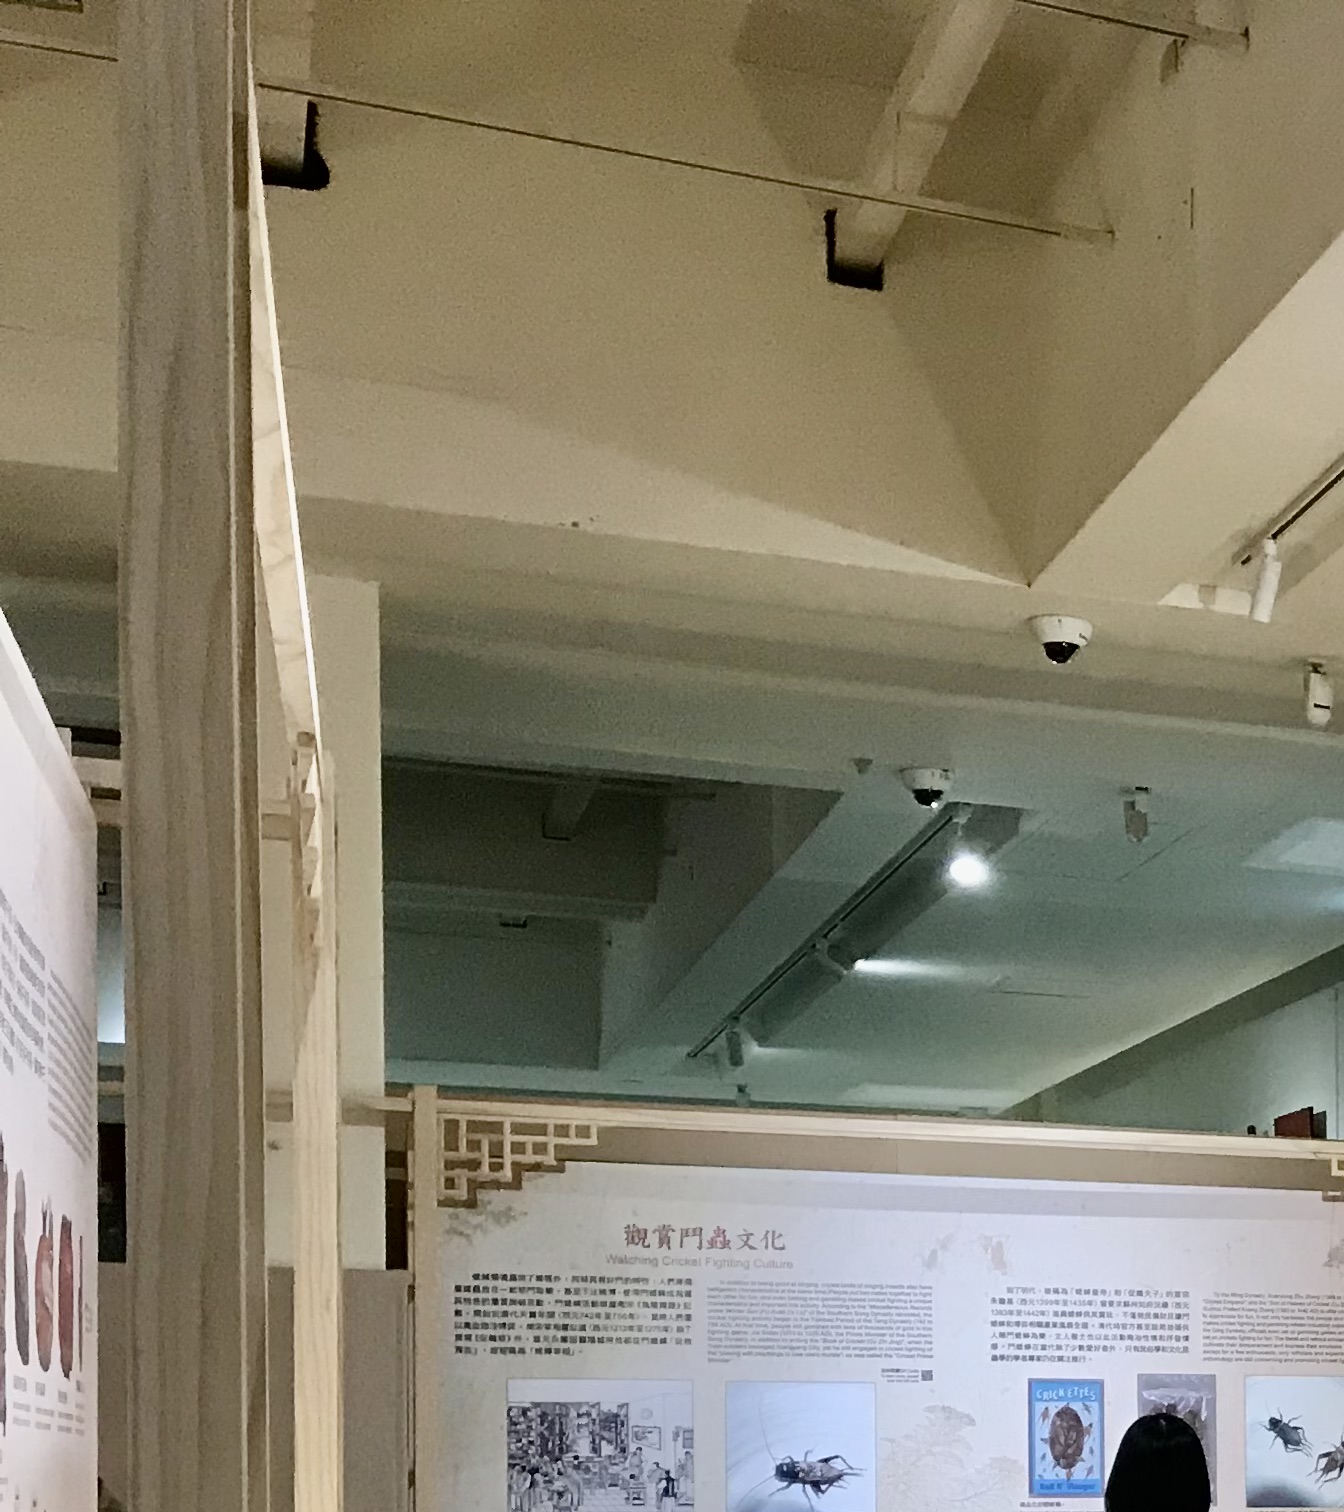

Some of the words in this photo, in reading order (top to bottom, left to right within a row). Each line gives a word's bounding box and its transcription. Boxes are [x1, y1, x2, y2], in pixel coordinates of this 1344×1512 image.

[624, 1224, 786, 1251] 觀賞鬥蟲文化
[605, 1254, 658, 1267] Watching
[662, 1255, 700, 1266] Cricket
[705, 1257, 750, 1270] Fighting
[753, 1258, 793, 1269] Culture
